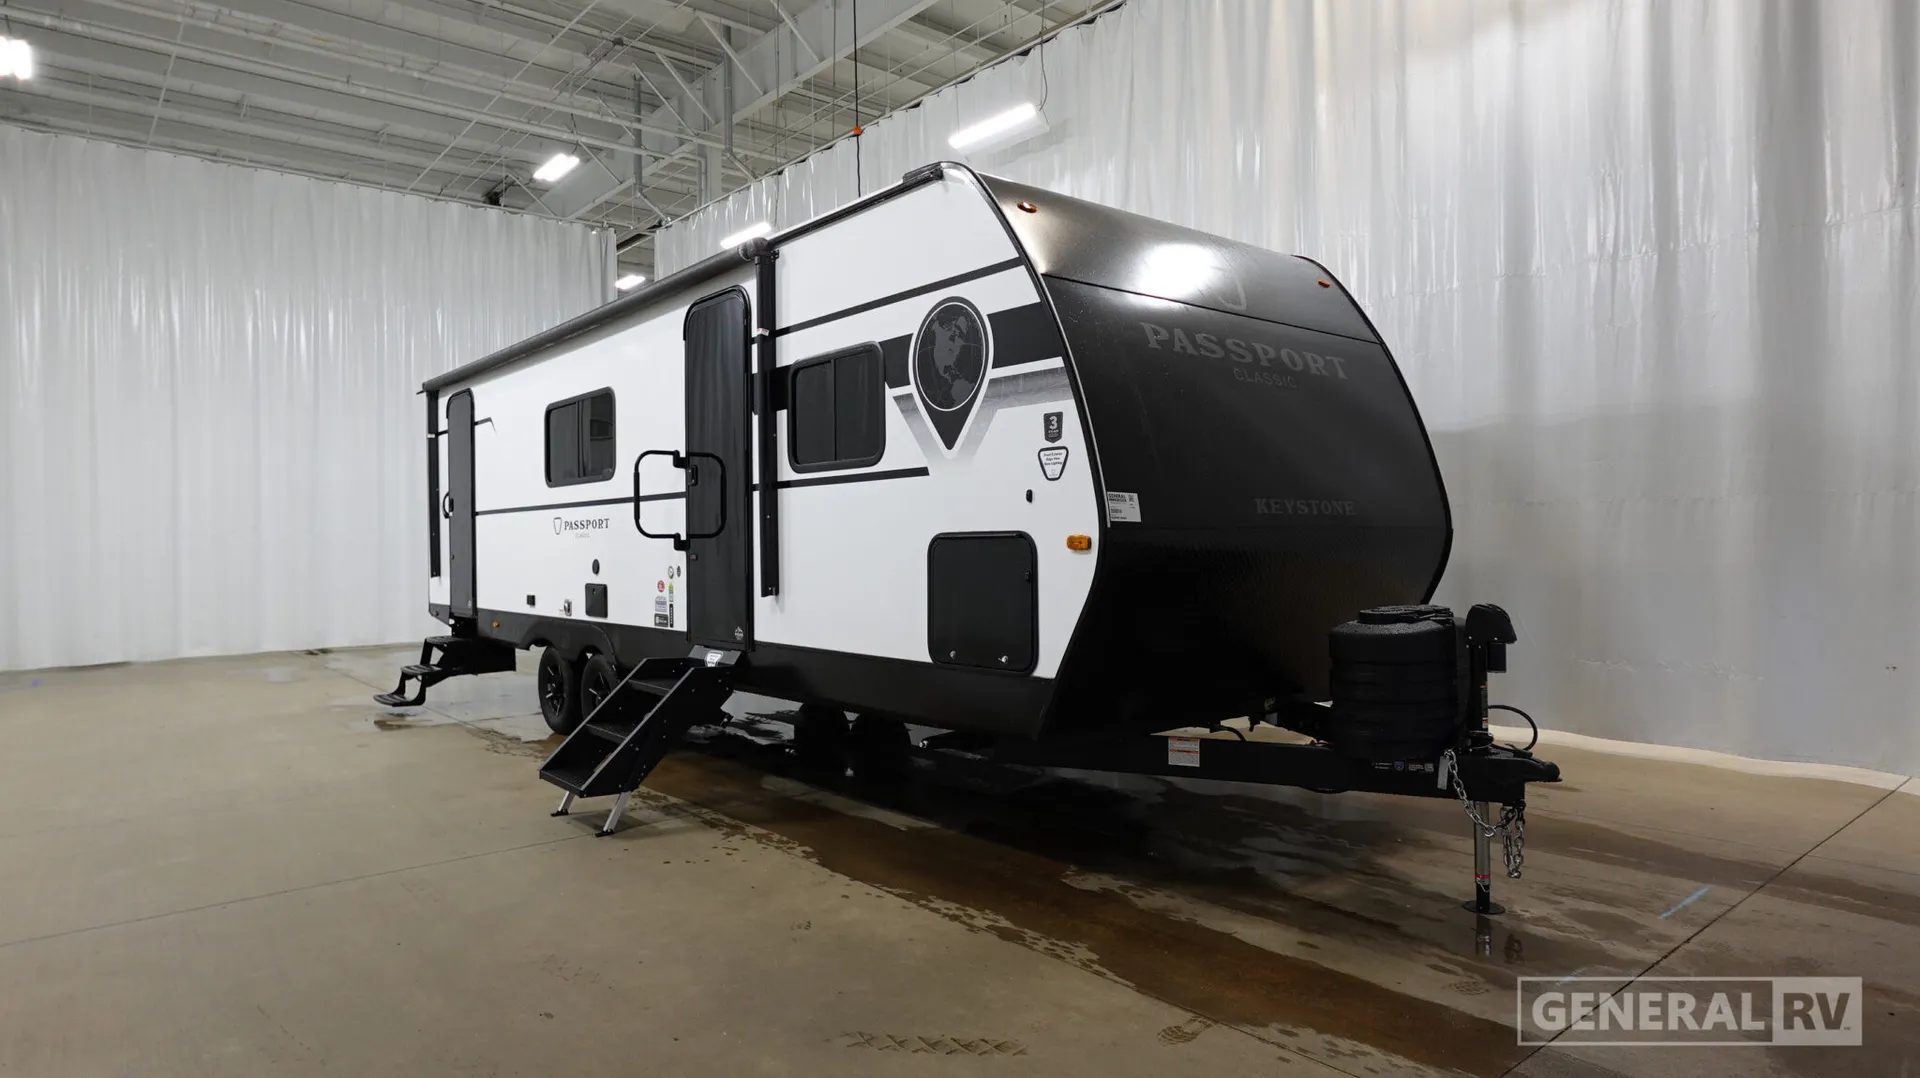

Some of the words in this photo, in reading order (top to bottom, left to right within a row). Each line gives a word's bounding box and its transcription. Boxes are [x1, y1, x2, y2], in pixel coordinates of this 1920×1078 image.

[1139, 321, 1348, 380] PASSPORT
[1232, 367, 1298, 390] CLASSIC
[1049, 415, 1058, 430] 3
[1253, 498, 1358, 516] KEYSTONE
[564, 518, 610, 531] PASSPORT
